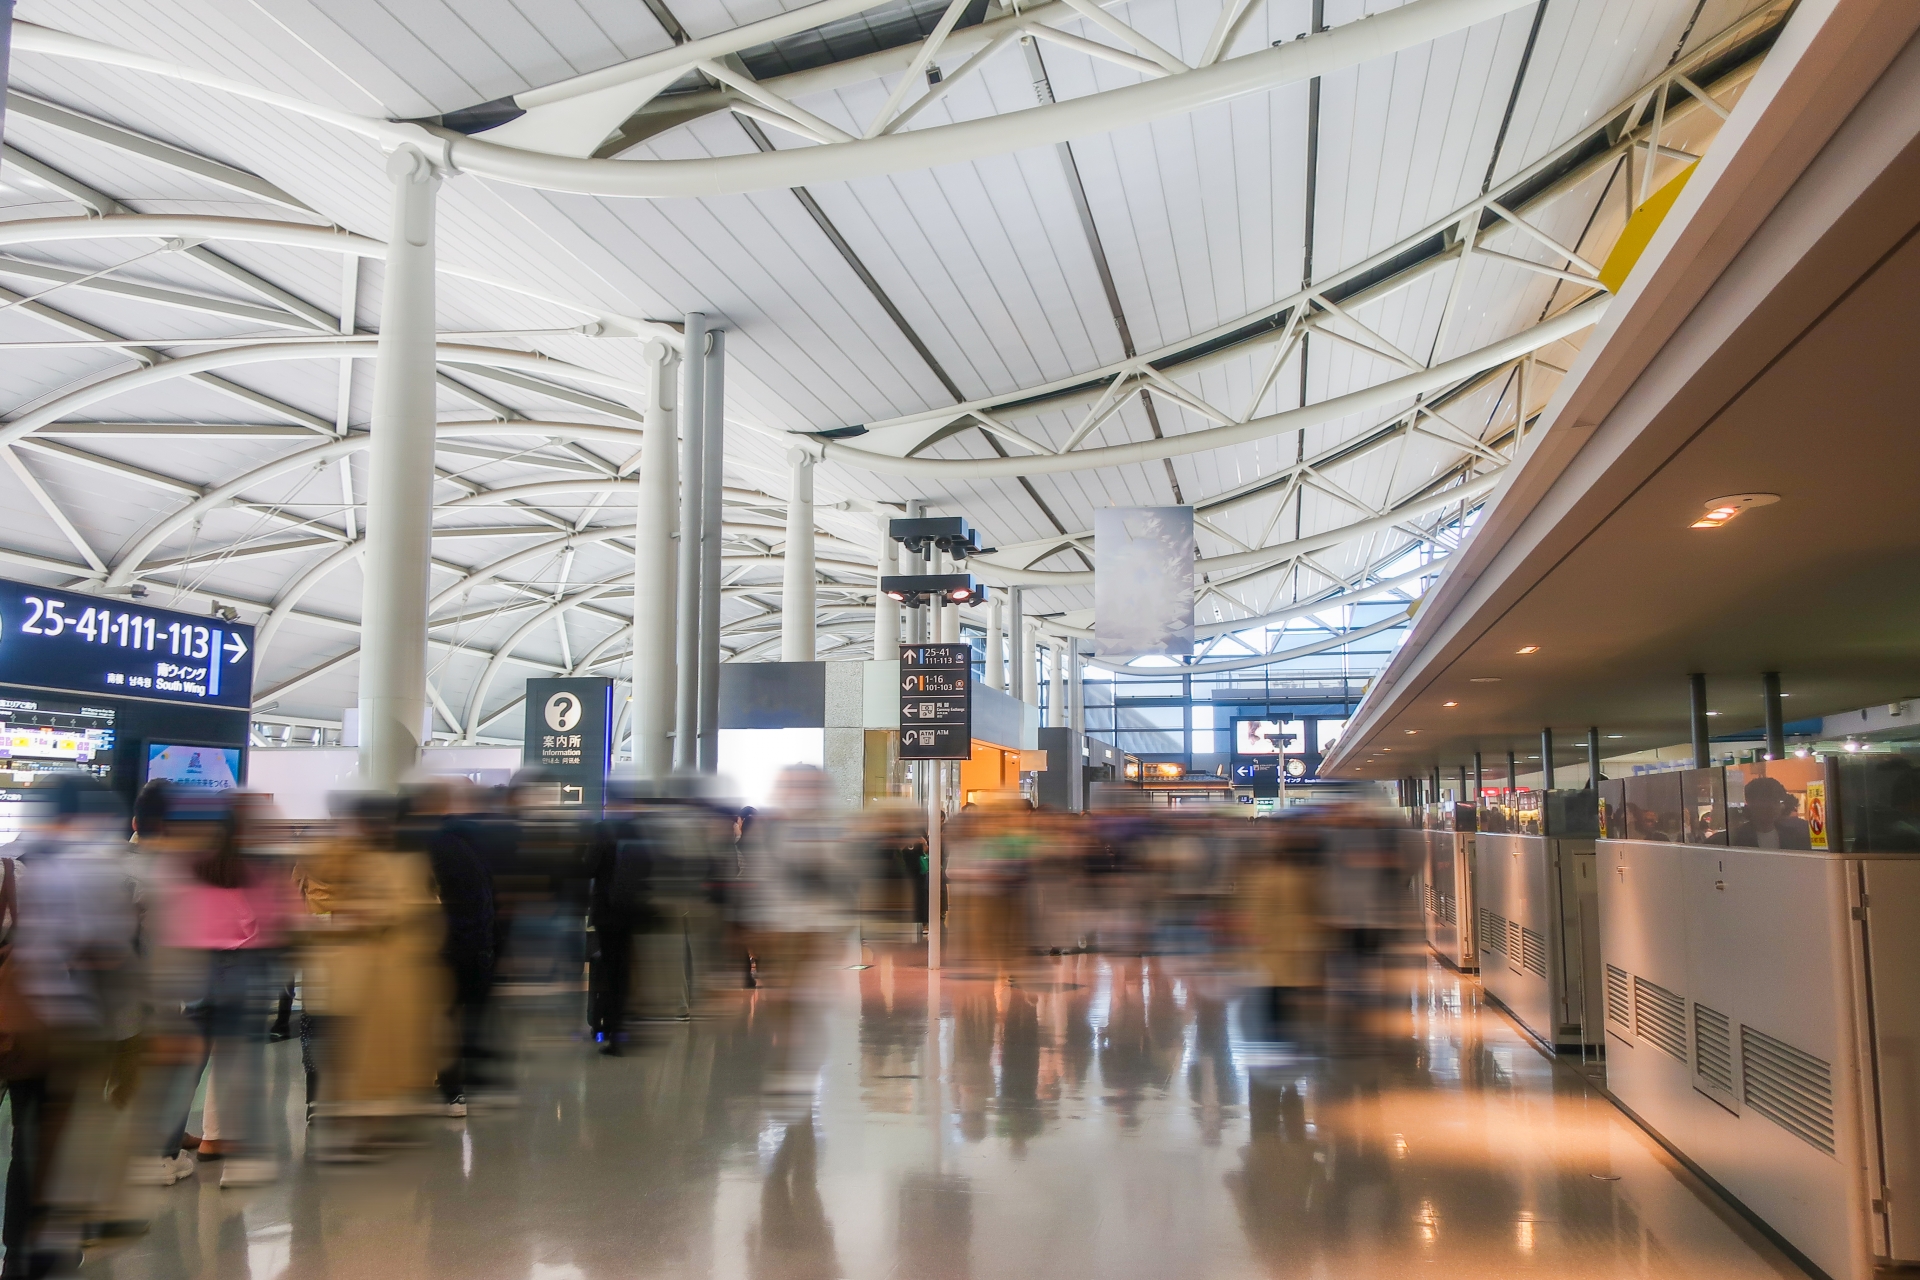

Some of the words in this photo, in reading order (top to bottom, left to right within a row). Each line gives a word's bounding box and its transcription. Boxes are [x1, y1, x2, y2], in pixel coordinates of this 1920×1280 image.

[925, 675, 943, 683] 1-16
[156, 678, 182, 691] South
[183, 682, 206, 697] Wing
[543, 734, 581, 748] 案内所
